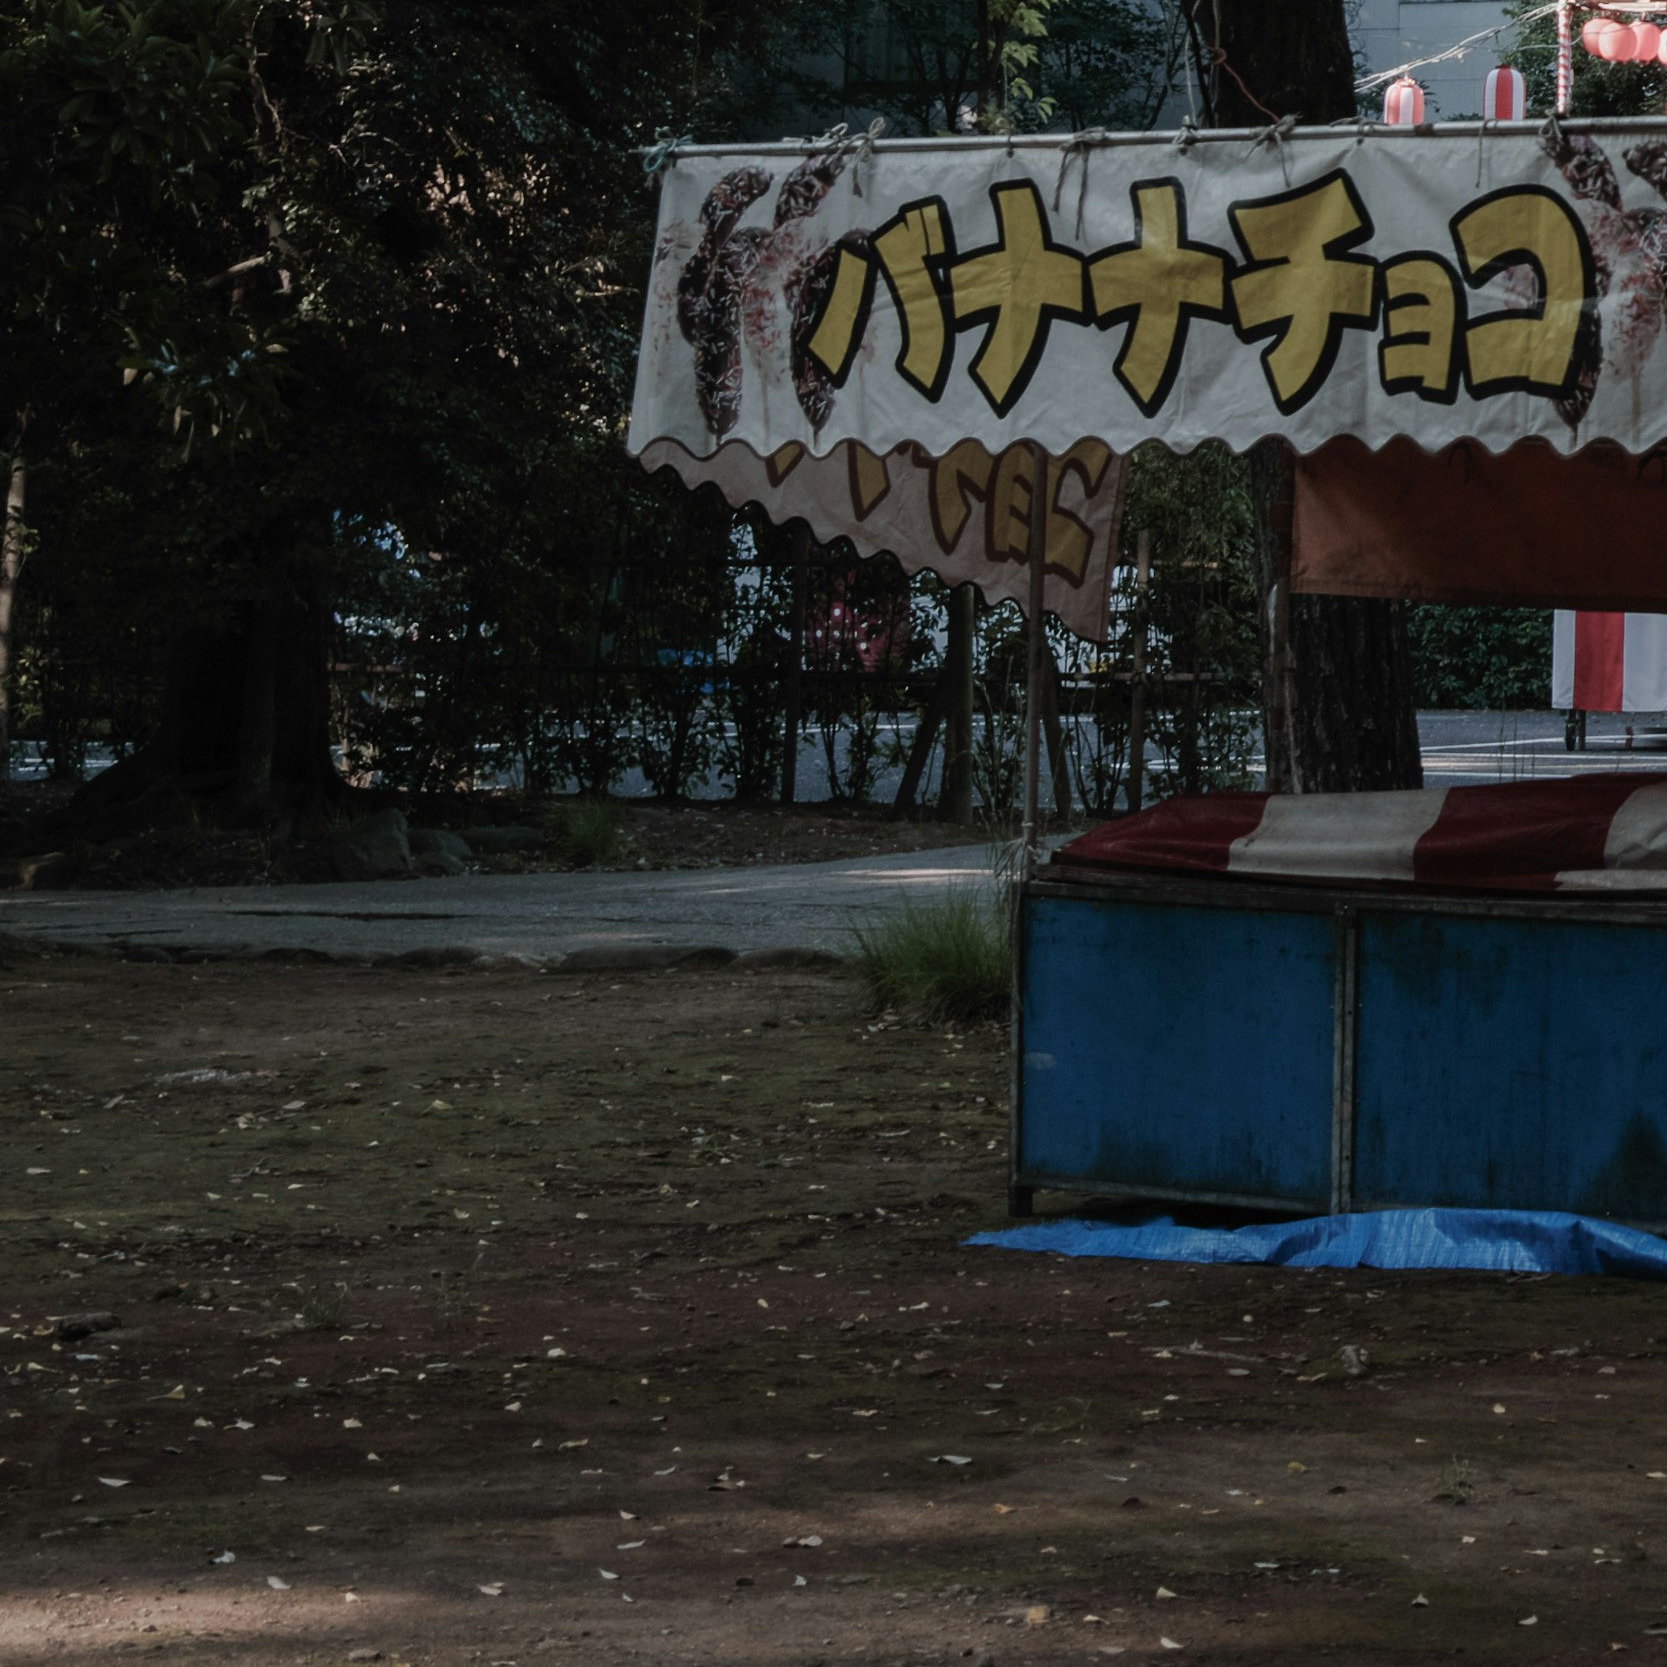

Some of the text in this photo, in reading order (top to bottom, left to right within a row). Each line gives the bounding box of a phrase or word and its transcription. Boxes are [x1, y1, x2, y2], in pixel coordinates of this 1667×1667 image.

[806, 167, 1597, 418] バナナチョコ
